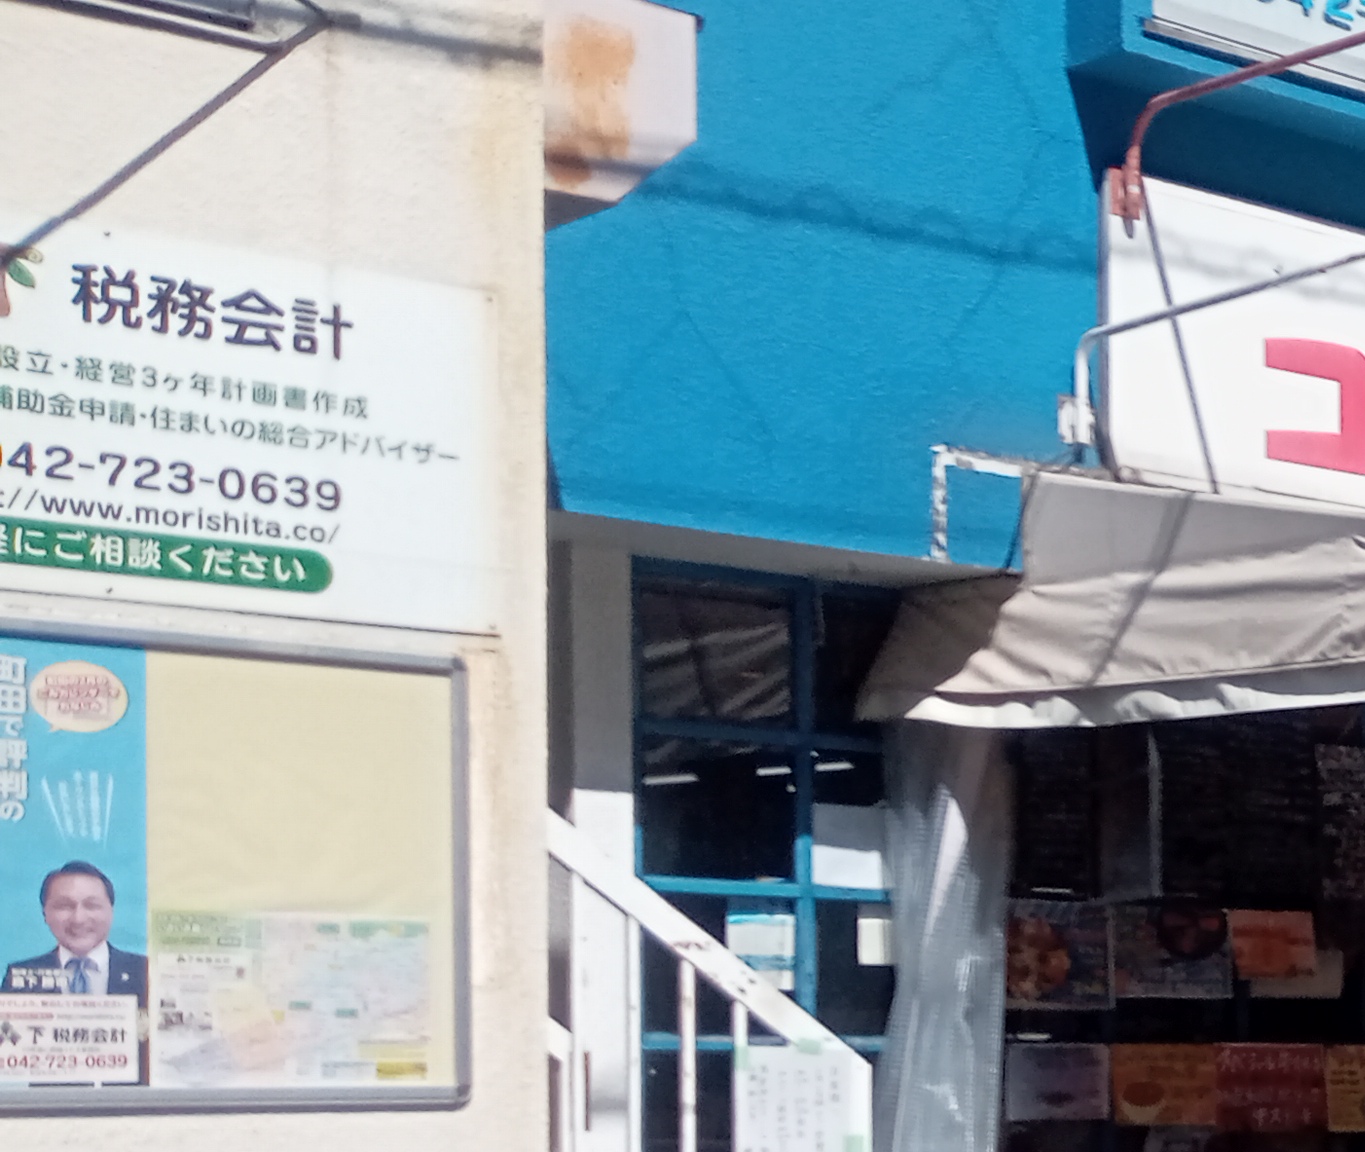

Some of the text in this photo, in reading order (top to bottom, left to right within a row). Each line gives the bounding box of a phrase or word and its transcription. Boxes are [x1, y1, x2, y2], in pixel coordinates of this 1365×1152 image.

[71, 262, 354, 361] 税務会計
[0, 441, 342, 511] 42-723-0639
[0, 522, 306, 583] にご相談ください
